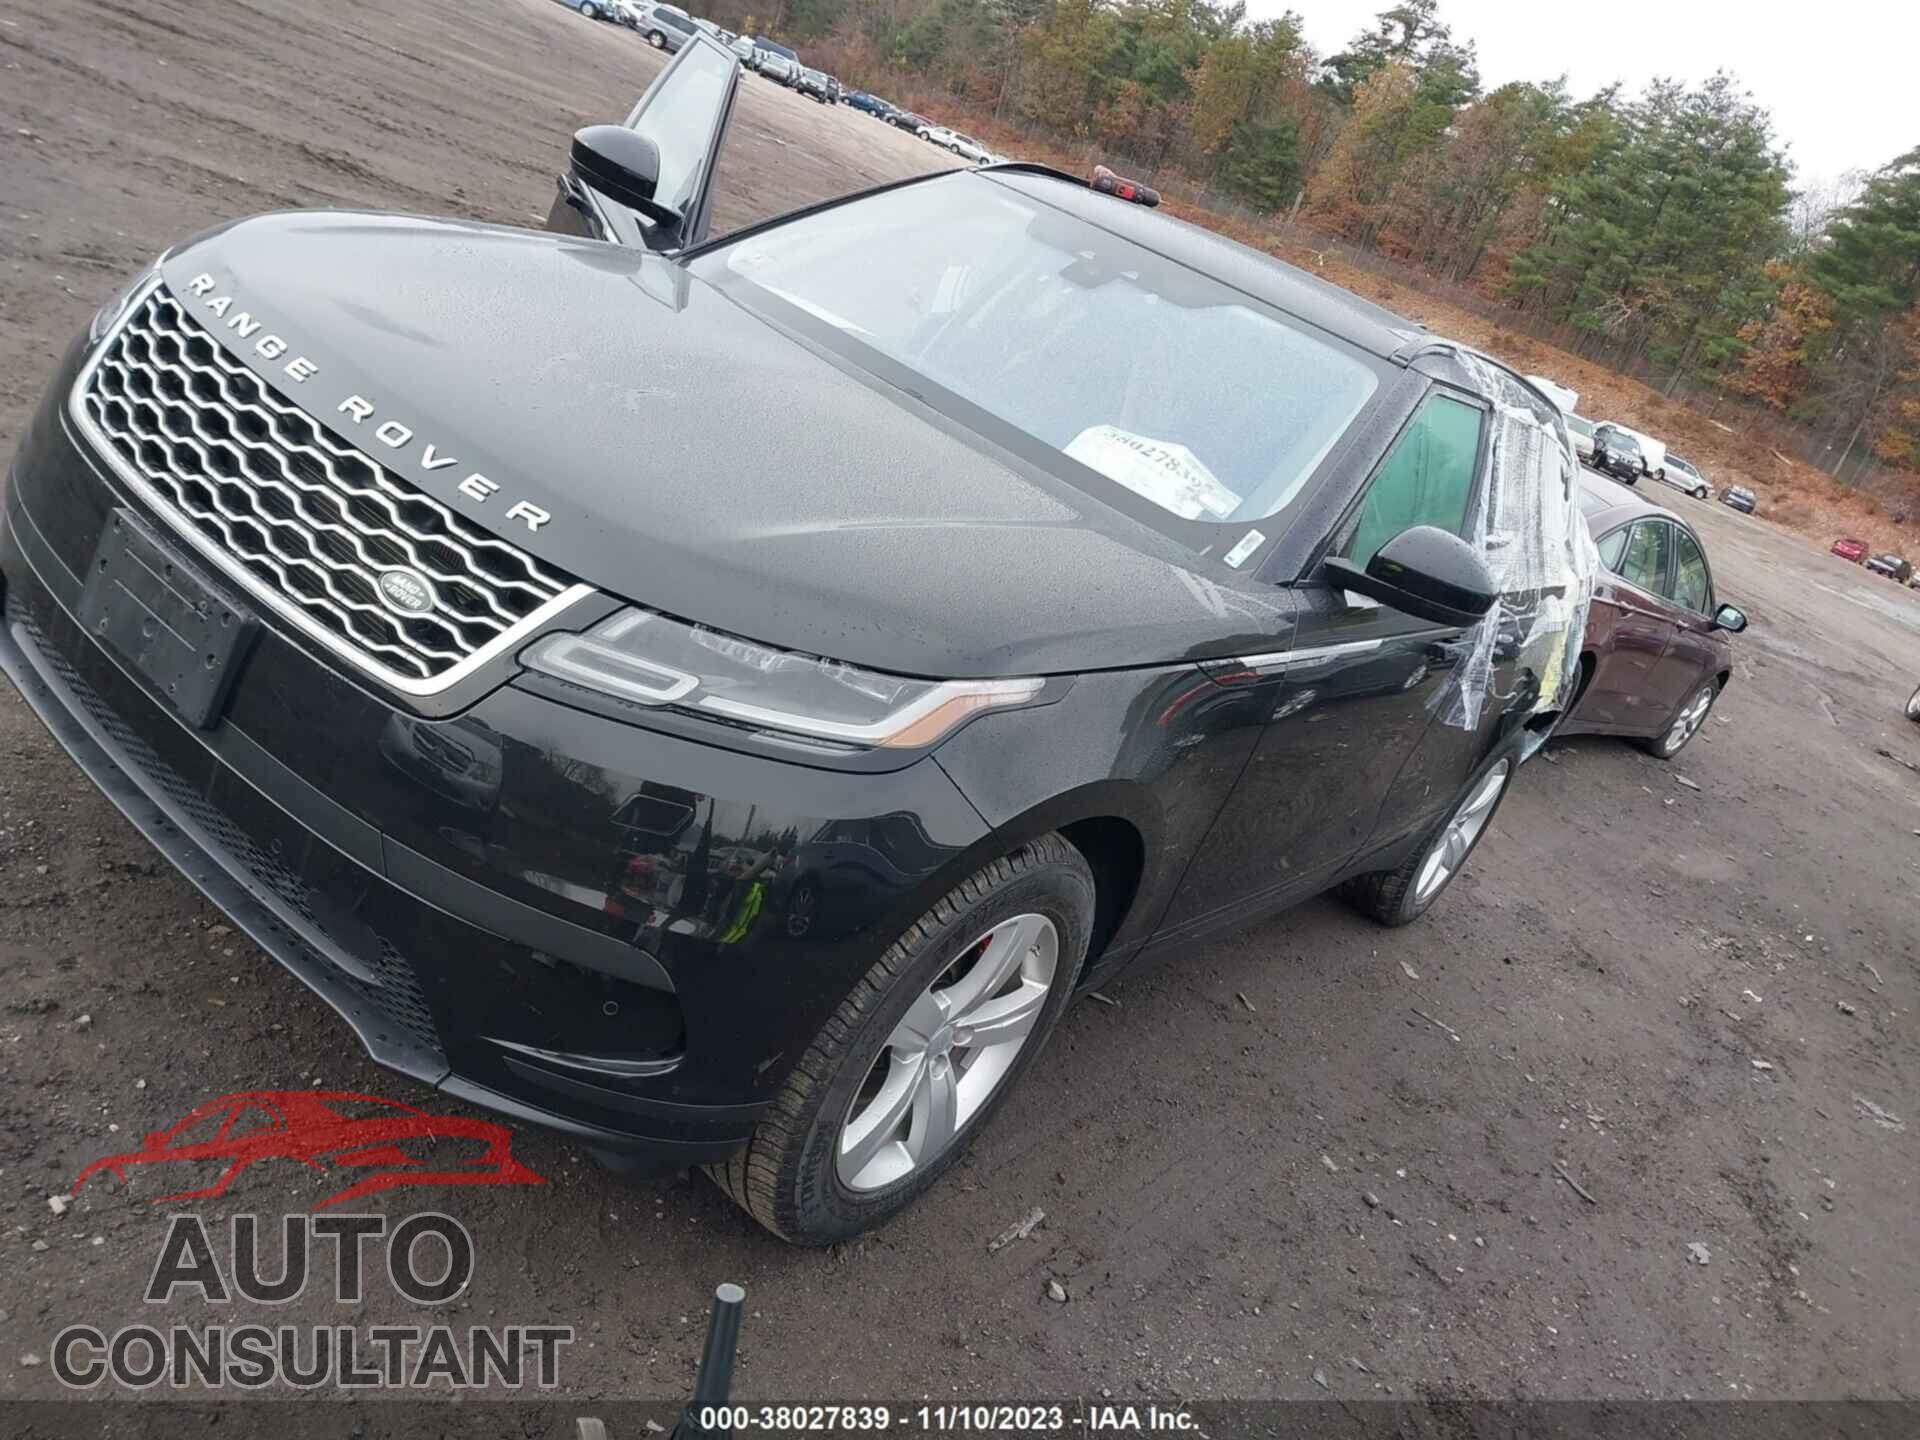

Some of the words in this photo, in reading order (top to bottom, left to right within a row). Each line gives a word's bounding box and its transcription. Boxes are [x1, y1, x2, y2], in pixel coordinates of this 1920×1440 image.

[187, 272, 319, 382] RANGE
[337, 394, 551, 533] ROVER
[387, 585, 422, 609] ROVER
